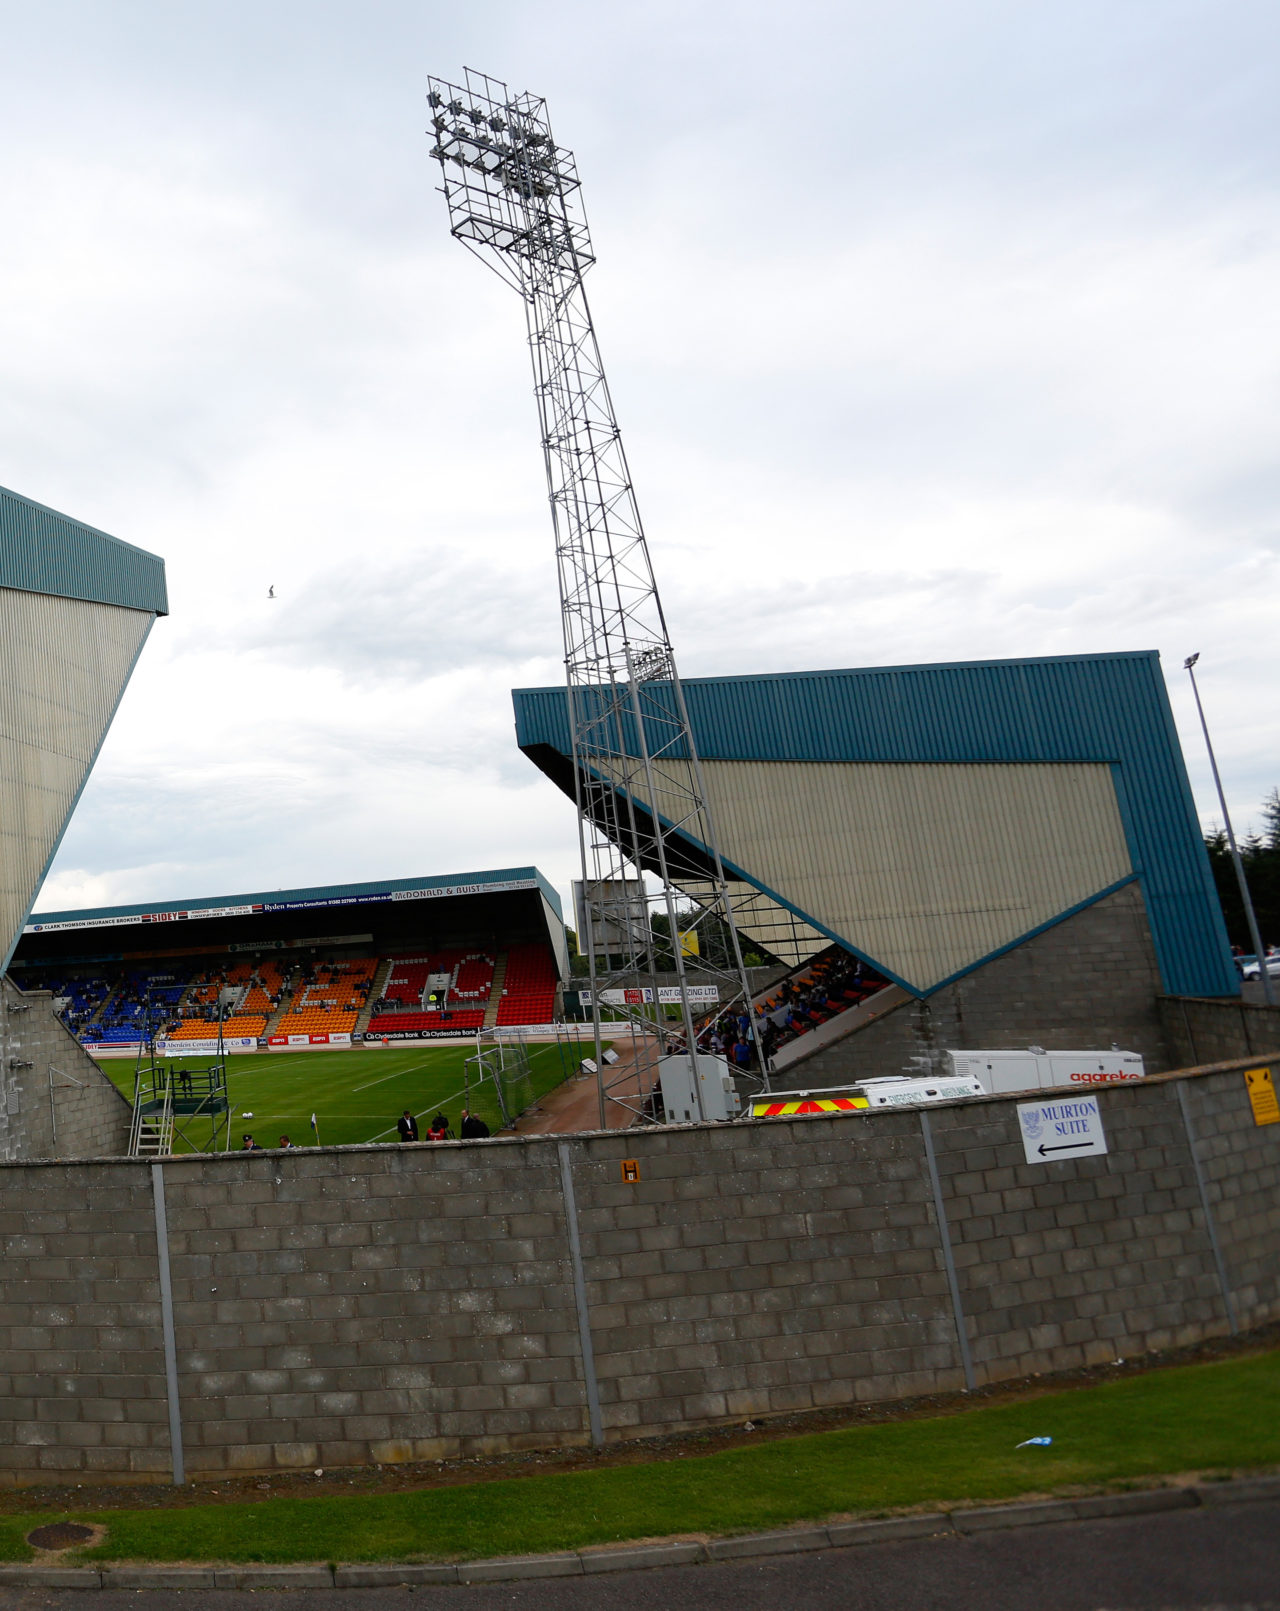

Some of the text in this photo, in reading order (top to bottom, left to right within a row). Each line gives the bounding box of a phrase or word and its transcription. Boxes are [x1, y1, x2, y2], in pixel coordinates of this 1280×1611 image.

[446, 887, 453, 895] &
[456, 885, 481, 894] BUIST
[264, 903, 285, 912] Ryden
[151, 911, 178, 923] SIDEY
[704, 987, 717, 995] LTD
[1041, 1102, 1097, 1121] MUIRTON
[1054, 1119, 1090, 1136] SUITE
[624, 1162, 638, 1180] H
